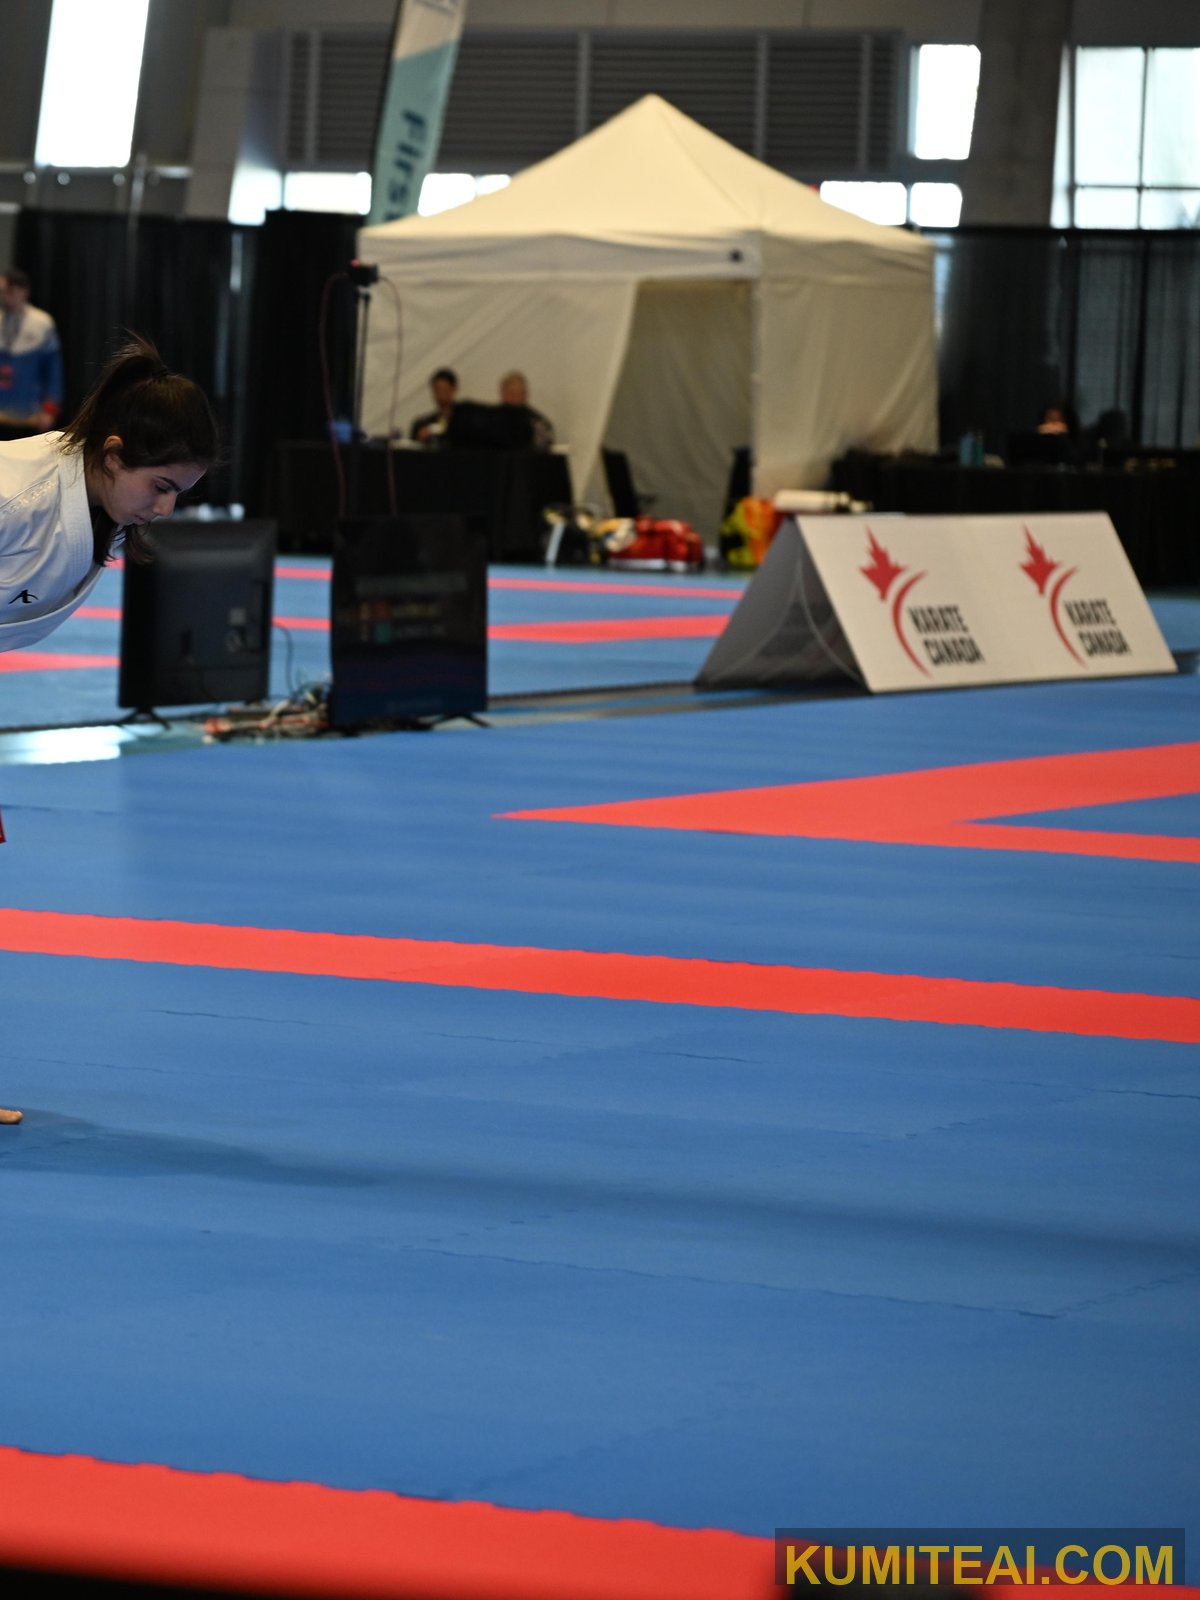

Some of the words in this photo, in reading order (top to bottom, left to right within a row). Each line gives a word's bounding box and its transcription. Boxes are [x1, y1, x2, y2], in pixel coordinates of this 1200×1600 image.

[907, 604, 969, 634] KARATE
[1064, 599, 1117, 627] KARATE
[923, 636, 985, 667] CANADA
[1078, 628, 1132, 657] CANADA
